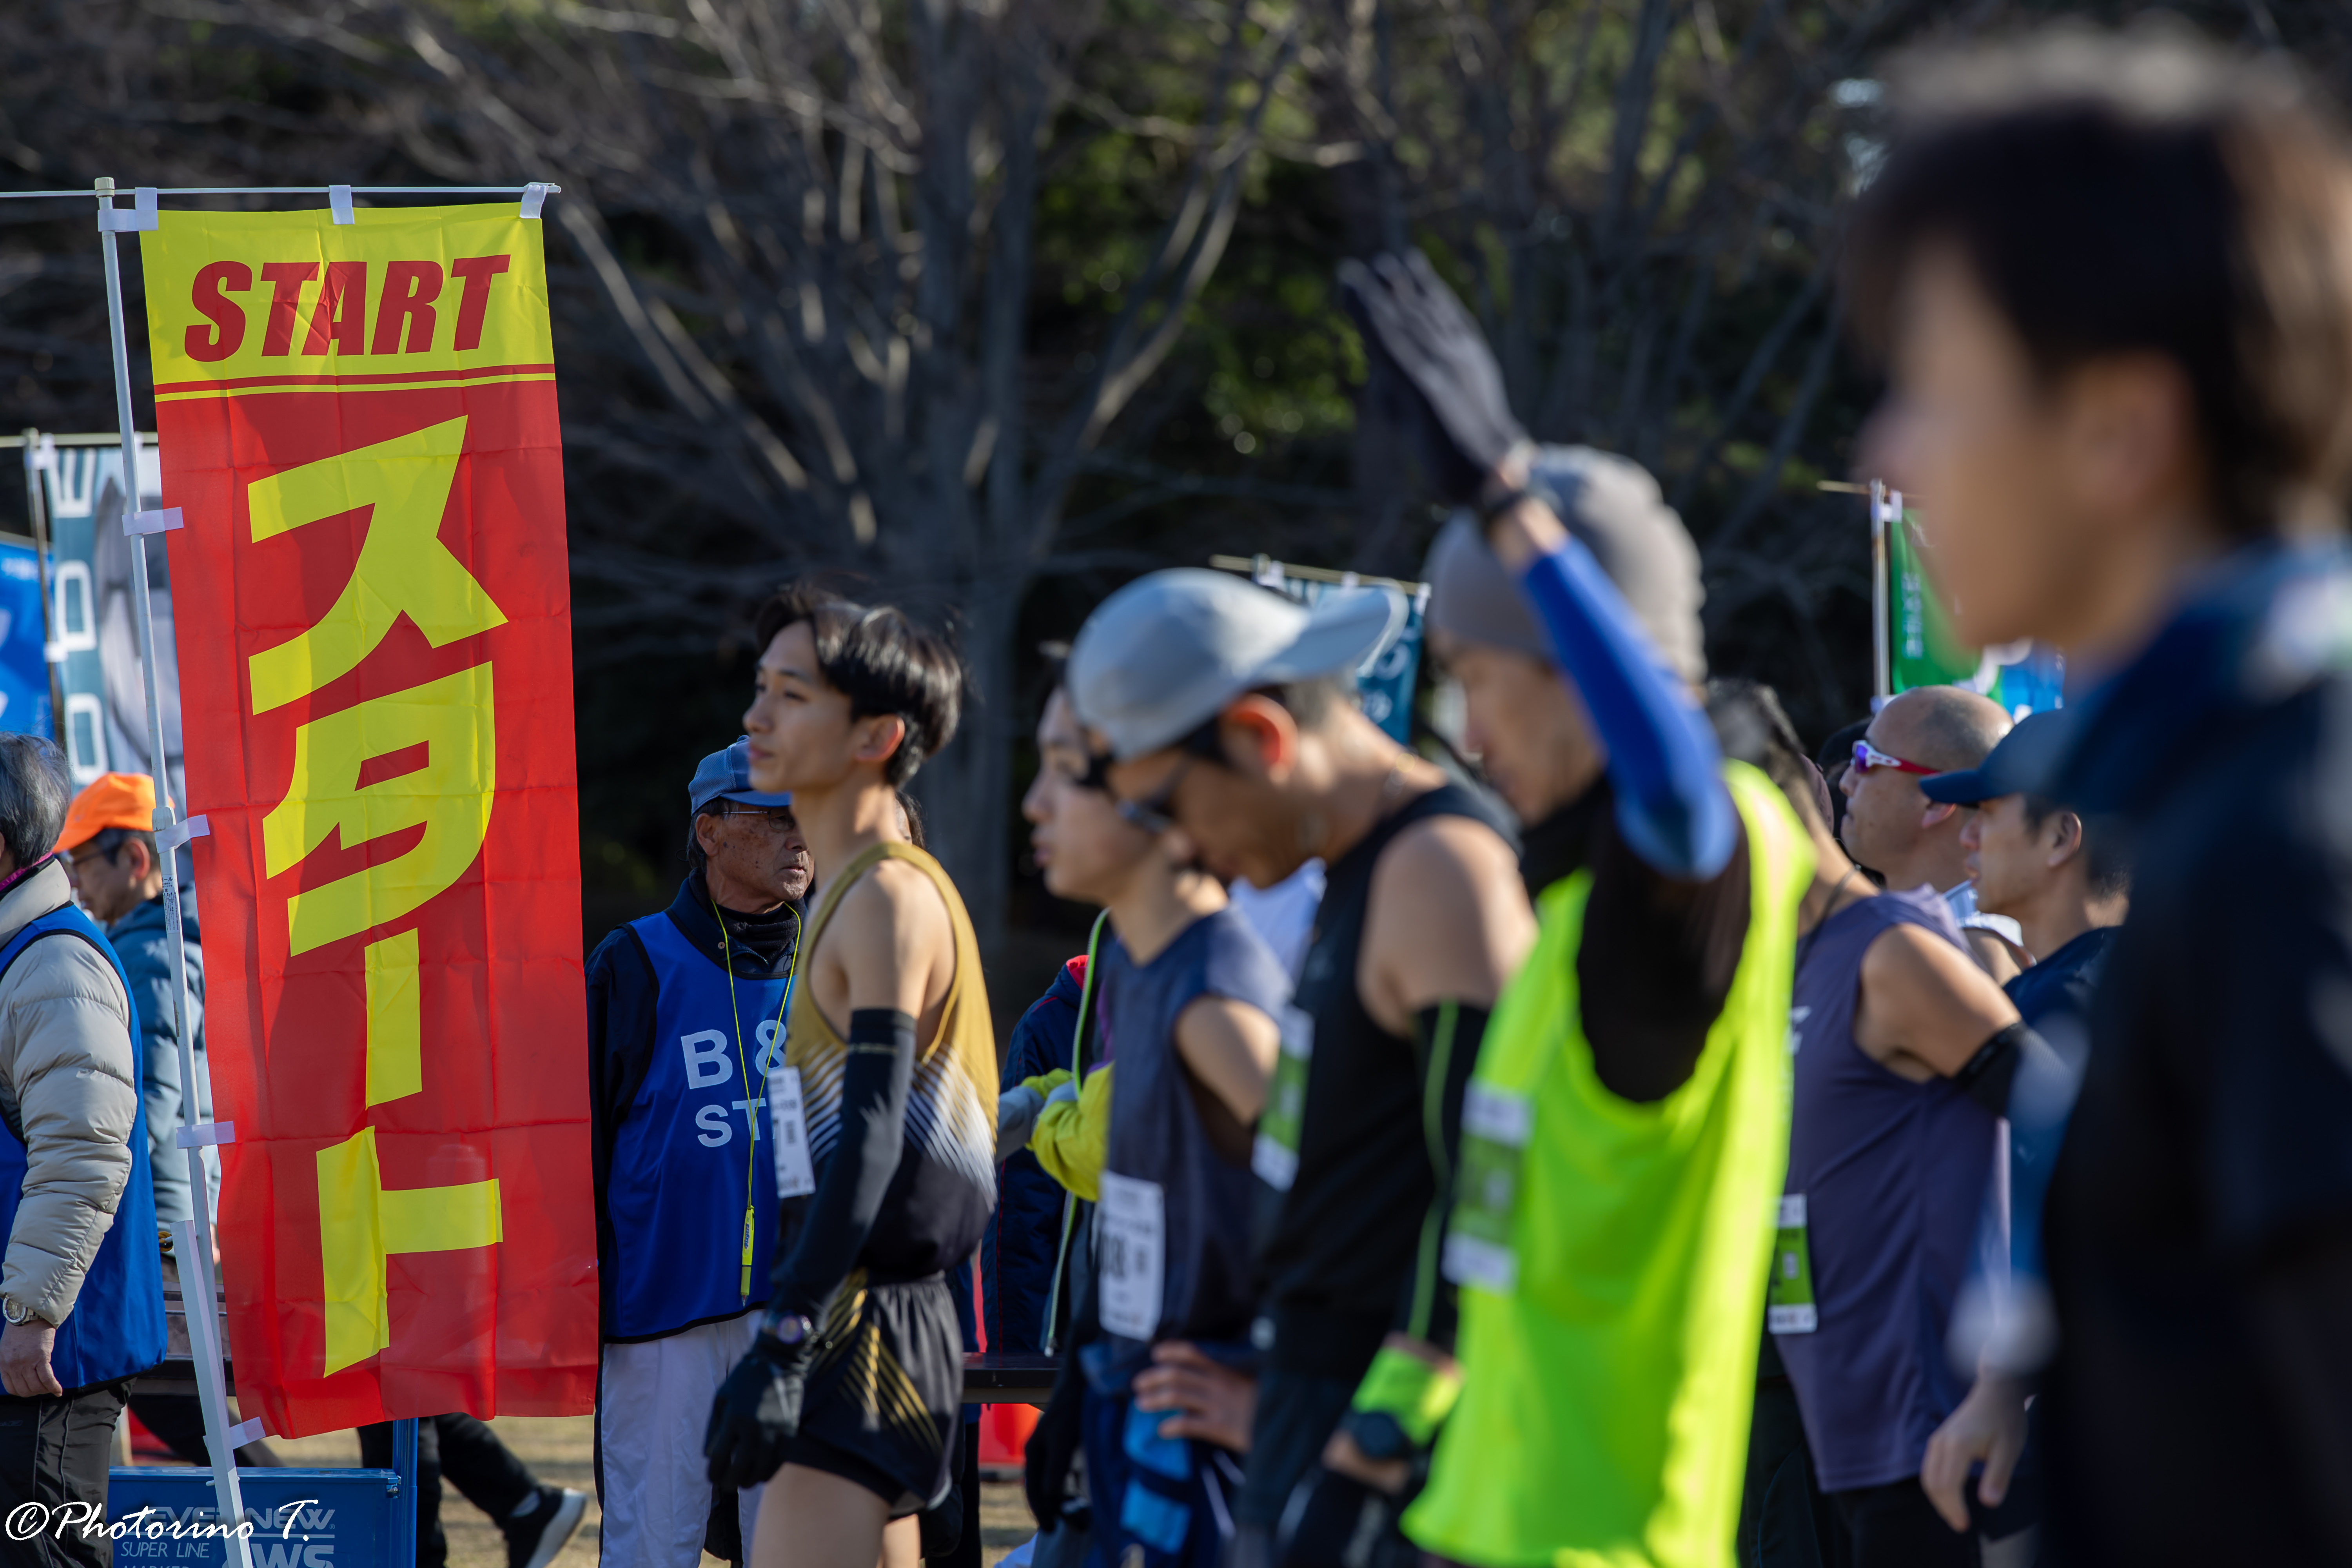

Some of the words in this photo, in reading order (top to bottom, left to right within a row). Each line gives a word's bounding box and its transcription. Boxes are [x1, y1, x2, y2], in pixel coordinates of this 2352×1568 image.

[184, 254, 511, 362] START
[248, 414, 507, 1378] スタート
[695, 1098, 776, 1147] ST
[144, 1507, 334, 1530] EVENEW
[121, 1541, 168, 1557] SUPER
[176, 1543, 210, 1558] LINE
[222, 1543, 334, 1568] WS
